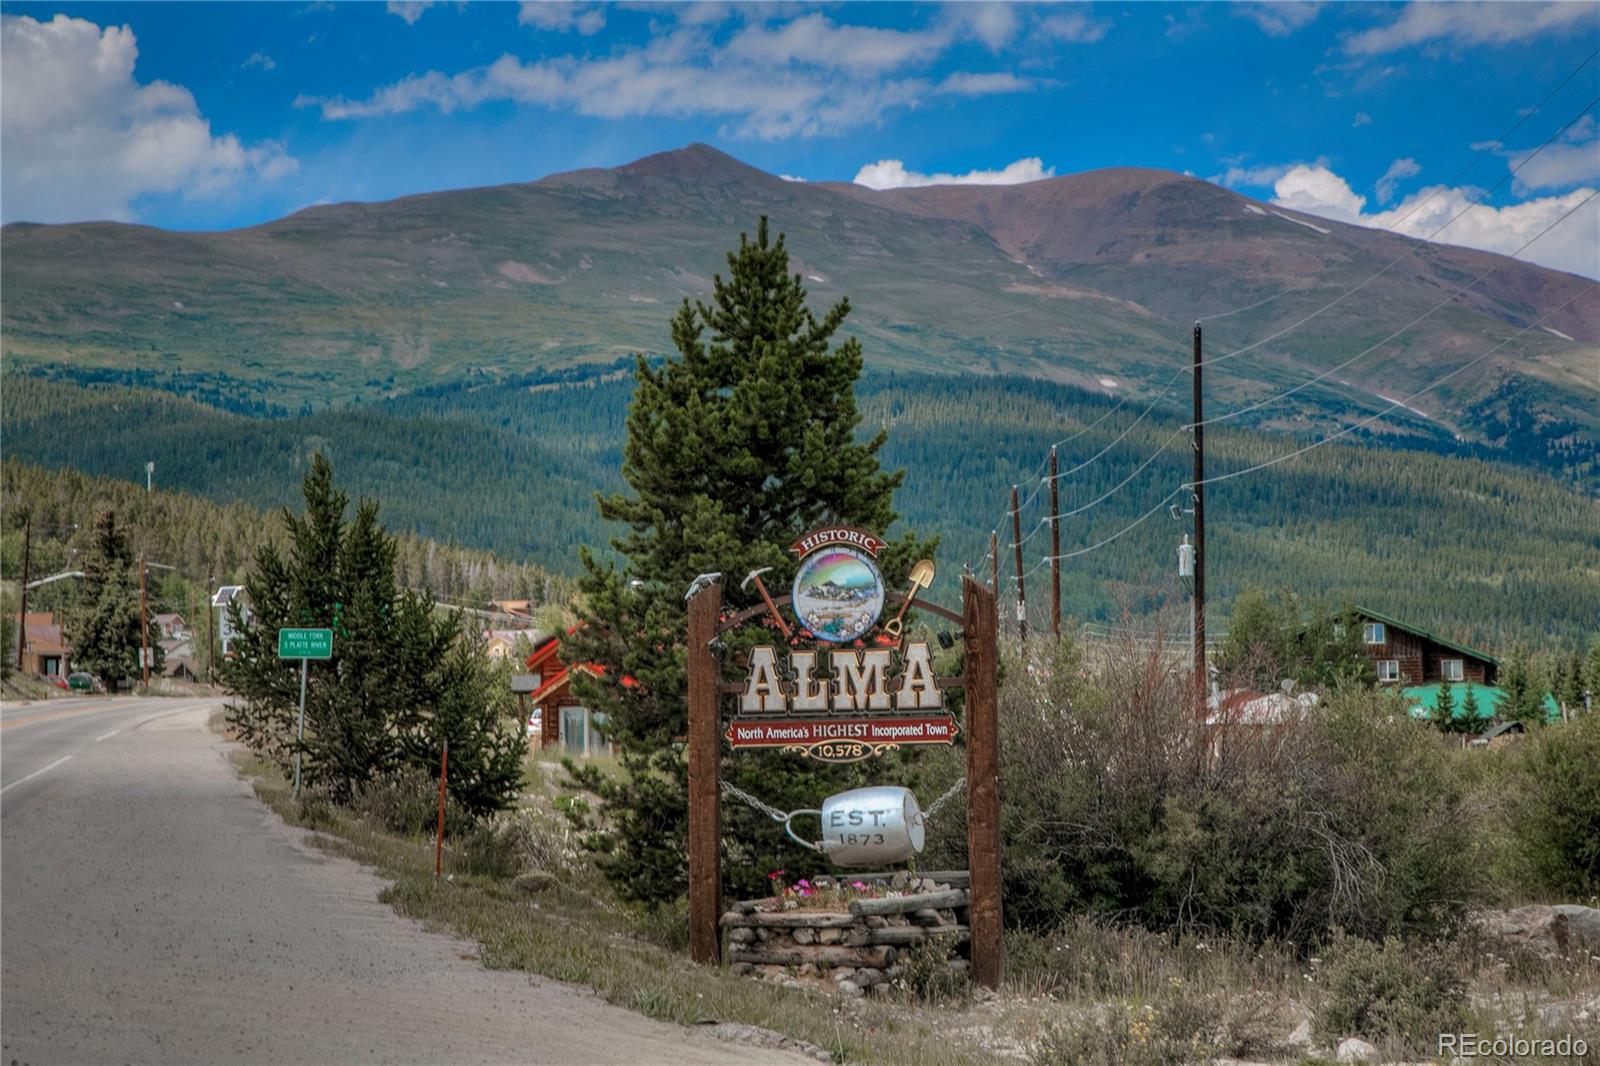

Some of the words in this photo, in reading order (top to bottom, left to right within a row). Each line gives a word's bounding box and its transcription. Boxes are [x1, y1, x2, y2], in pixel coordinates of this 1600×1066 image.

[801, 530, 876, 550] HISTORIC
[740, 643, 944, 713] ALMA
[737, 727, 764, 740] North
[766, 726, 810, 739] America's
[813, 724, 870, 737] HIGHEST
[871, 723, 924, 740] Incorporated
[926, 723, 948, 736] Town
[830, 809, 886, 827] EST.
[839, 833, 885, 846] 1873
